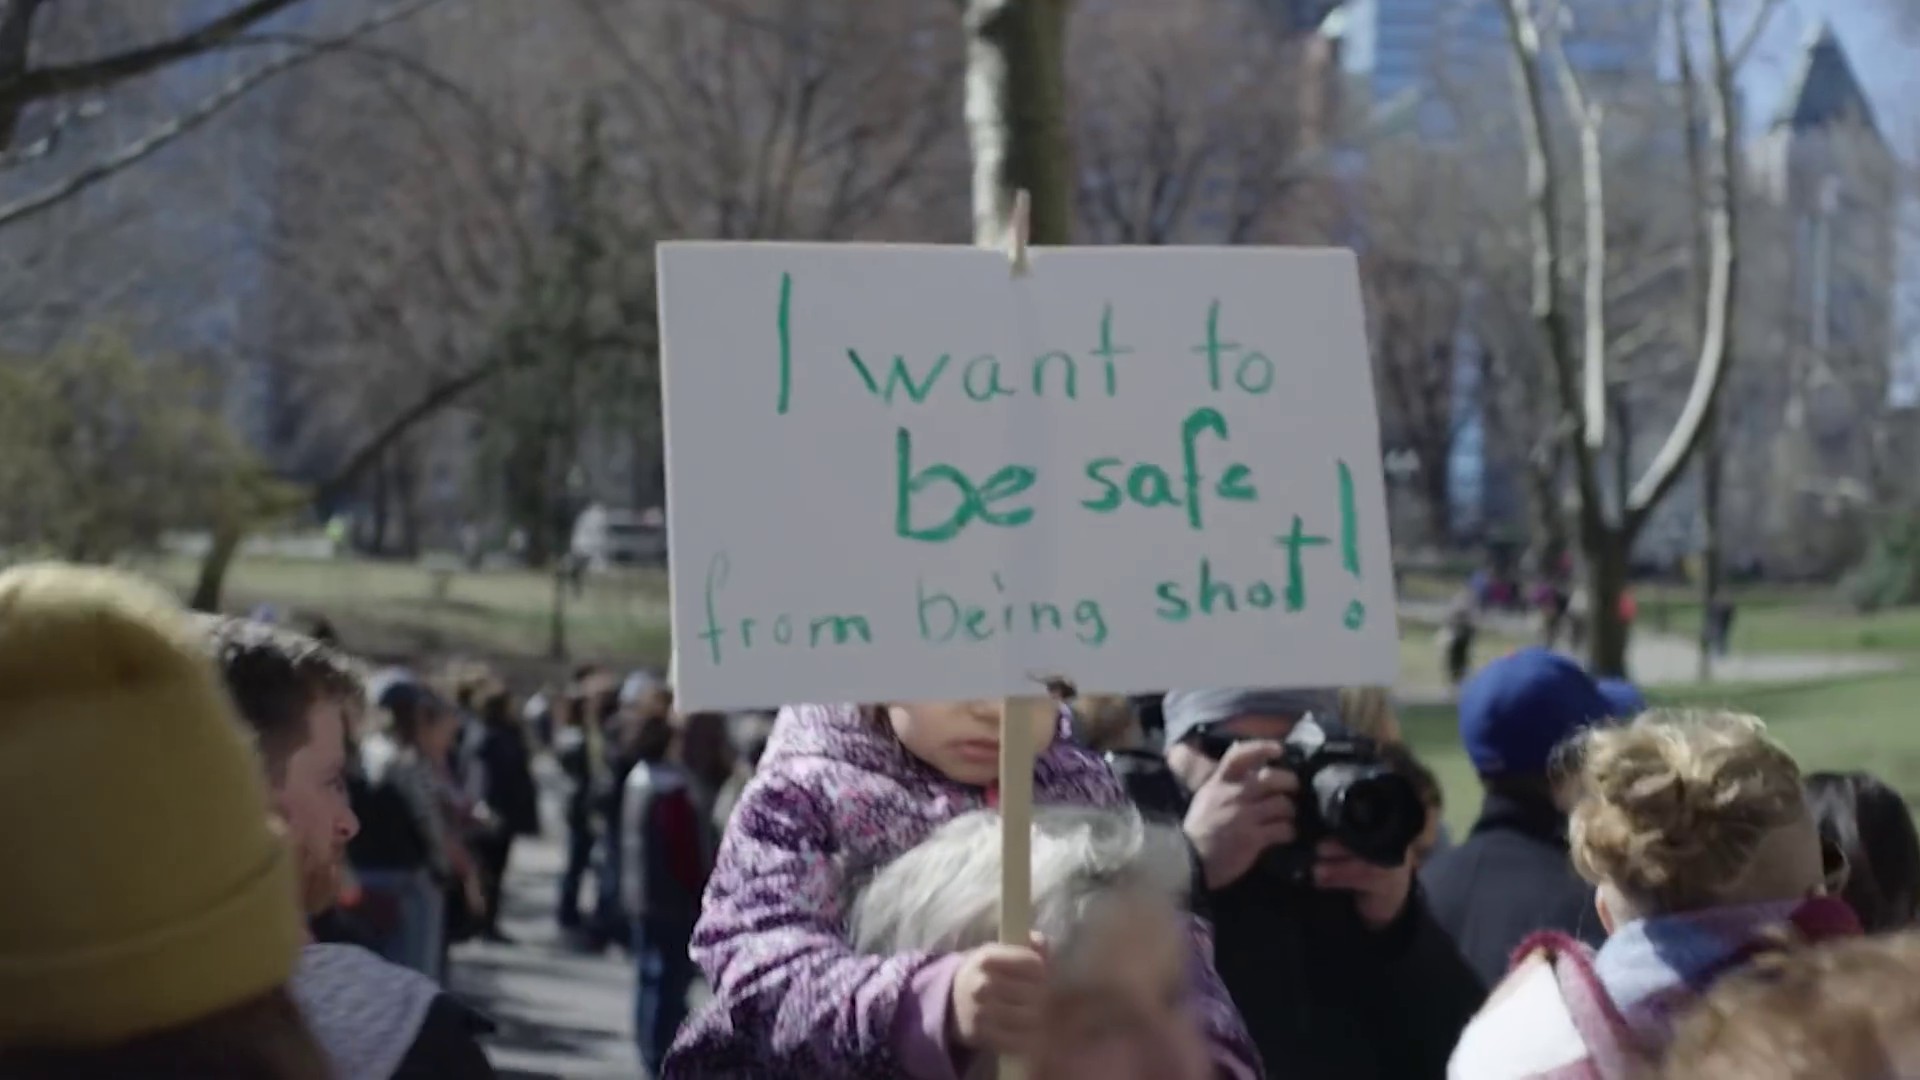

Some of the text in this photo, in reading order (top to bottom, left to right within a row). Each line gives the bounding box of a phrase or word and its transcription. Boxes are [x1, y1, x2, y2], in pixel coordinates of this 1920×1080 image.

[775, 272, 1276, 415] I want to
[894, 407, 1259, 544] be safe
[697, 550, 873, 665] from
[915, 570, 1110, 649] being
